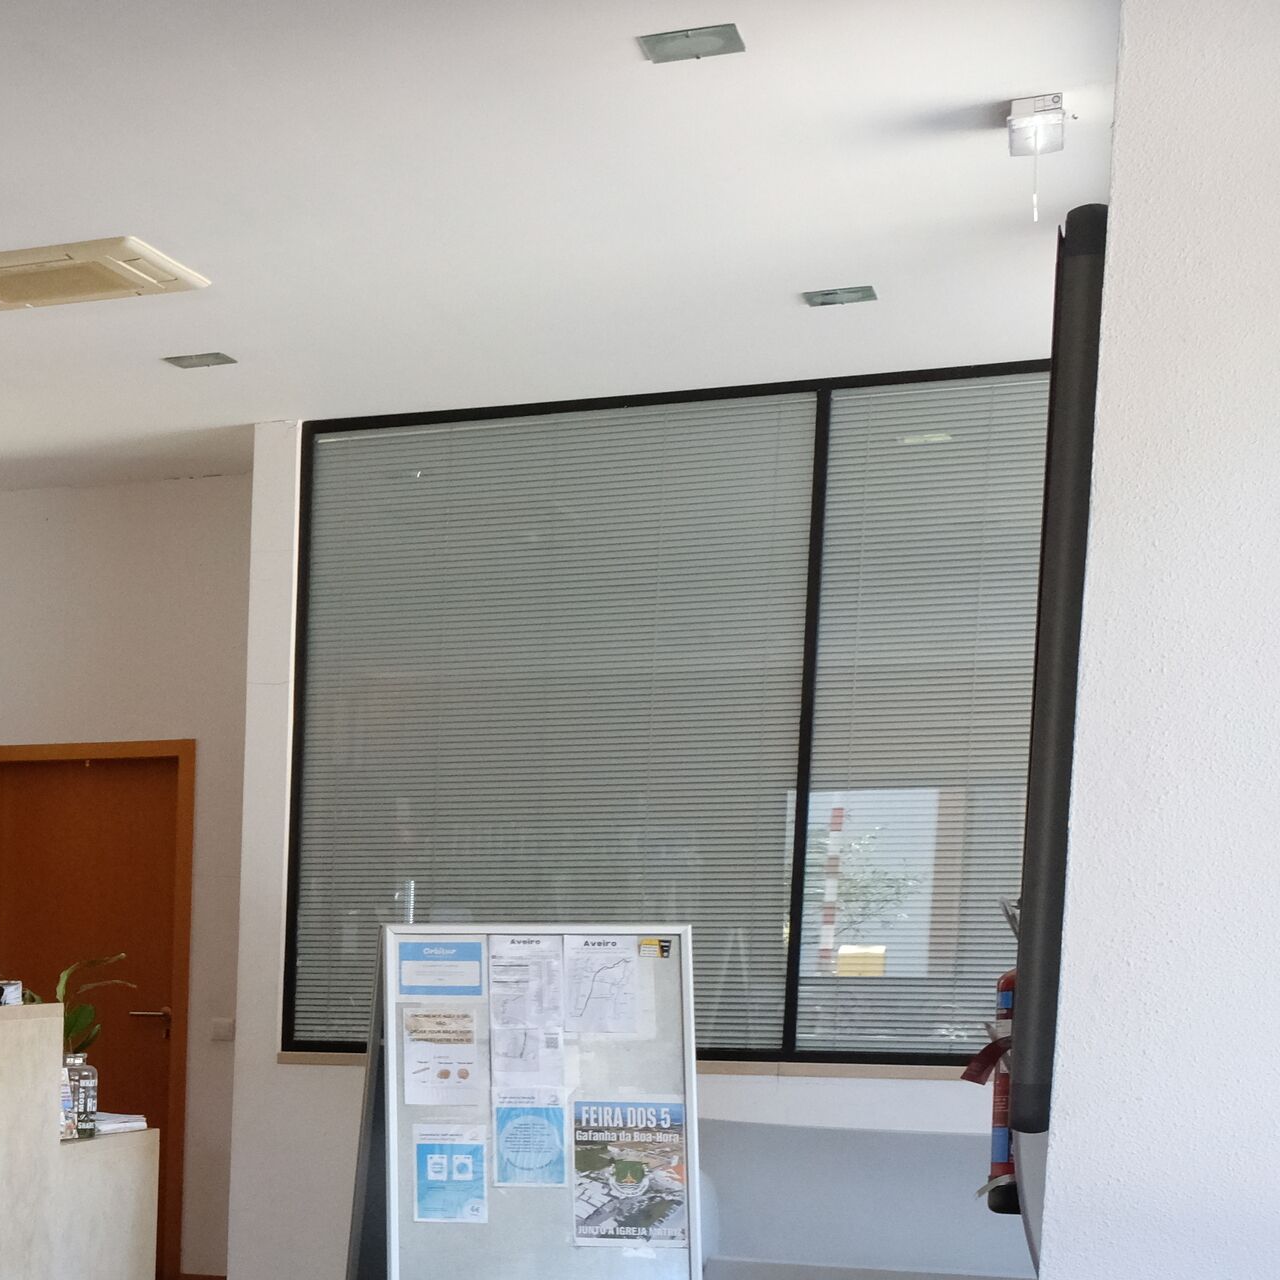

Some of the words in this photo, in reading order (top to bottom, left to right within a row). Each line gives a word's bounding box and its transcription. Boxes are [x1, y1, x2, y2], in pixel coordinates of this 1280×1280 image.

[582, 1106, 624, 1127] FEIRA
[627, 1107, 657, 1128] DOS
[660, 1107, 671, 1128] 5
[575, 1130, 617, 1141] Gafanha
[619, 1130, 631, 1141] da
[633, 1131, 680, 1142] Boa-Hora
[616, 1226, 648, 1236] IGREJA
